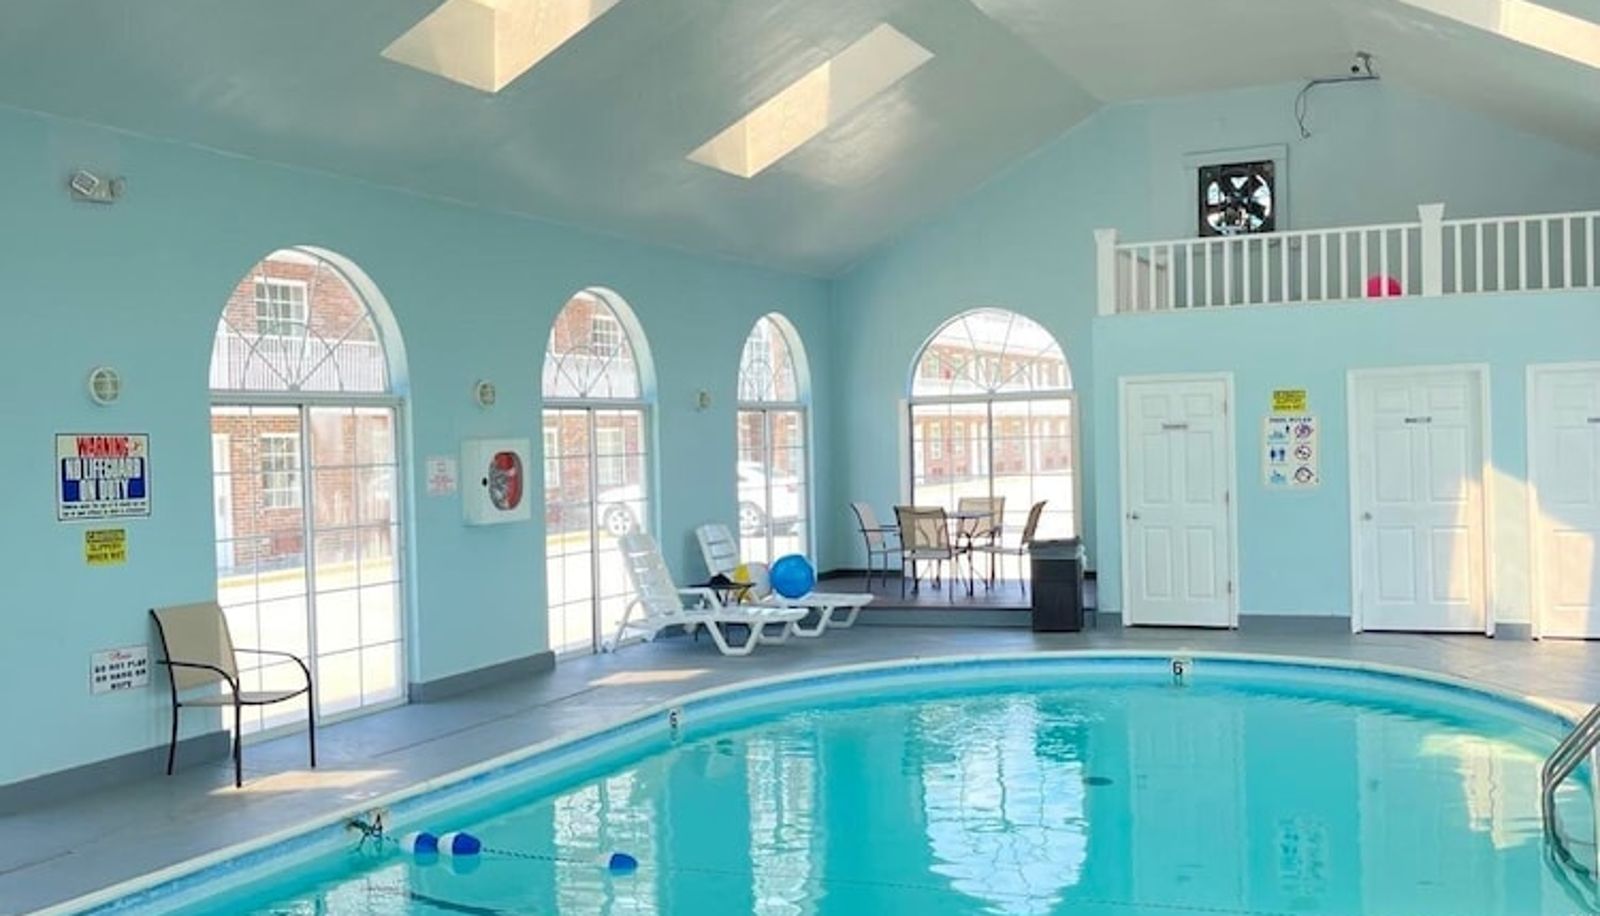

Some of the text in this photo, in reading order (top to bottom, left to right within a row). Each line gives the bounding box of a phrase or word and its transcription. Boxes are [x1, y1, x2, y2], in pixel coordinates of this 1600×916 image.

[76, 436, 129, 458] WARNING
[65, 457, 142, 480] NO LIFEGUARD
[80, 478, 128, 500] ON DUTY
[1172, 661, 1183, 675] 6
